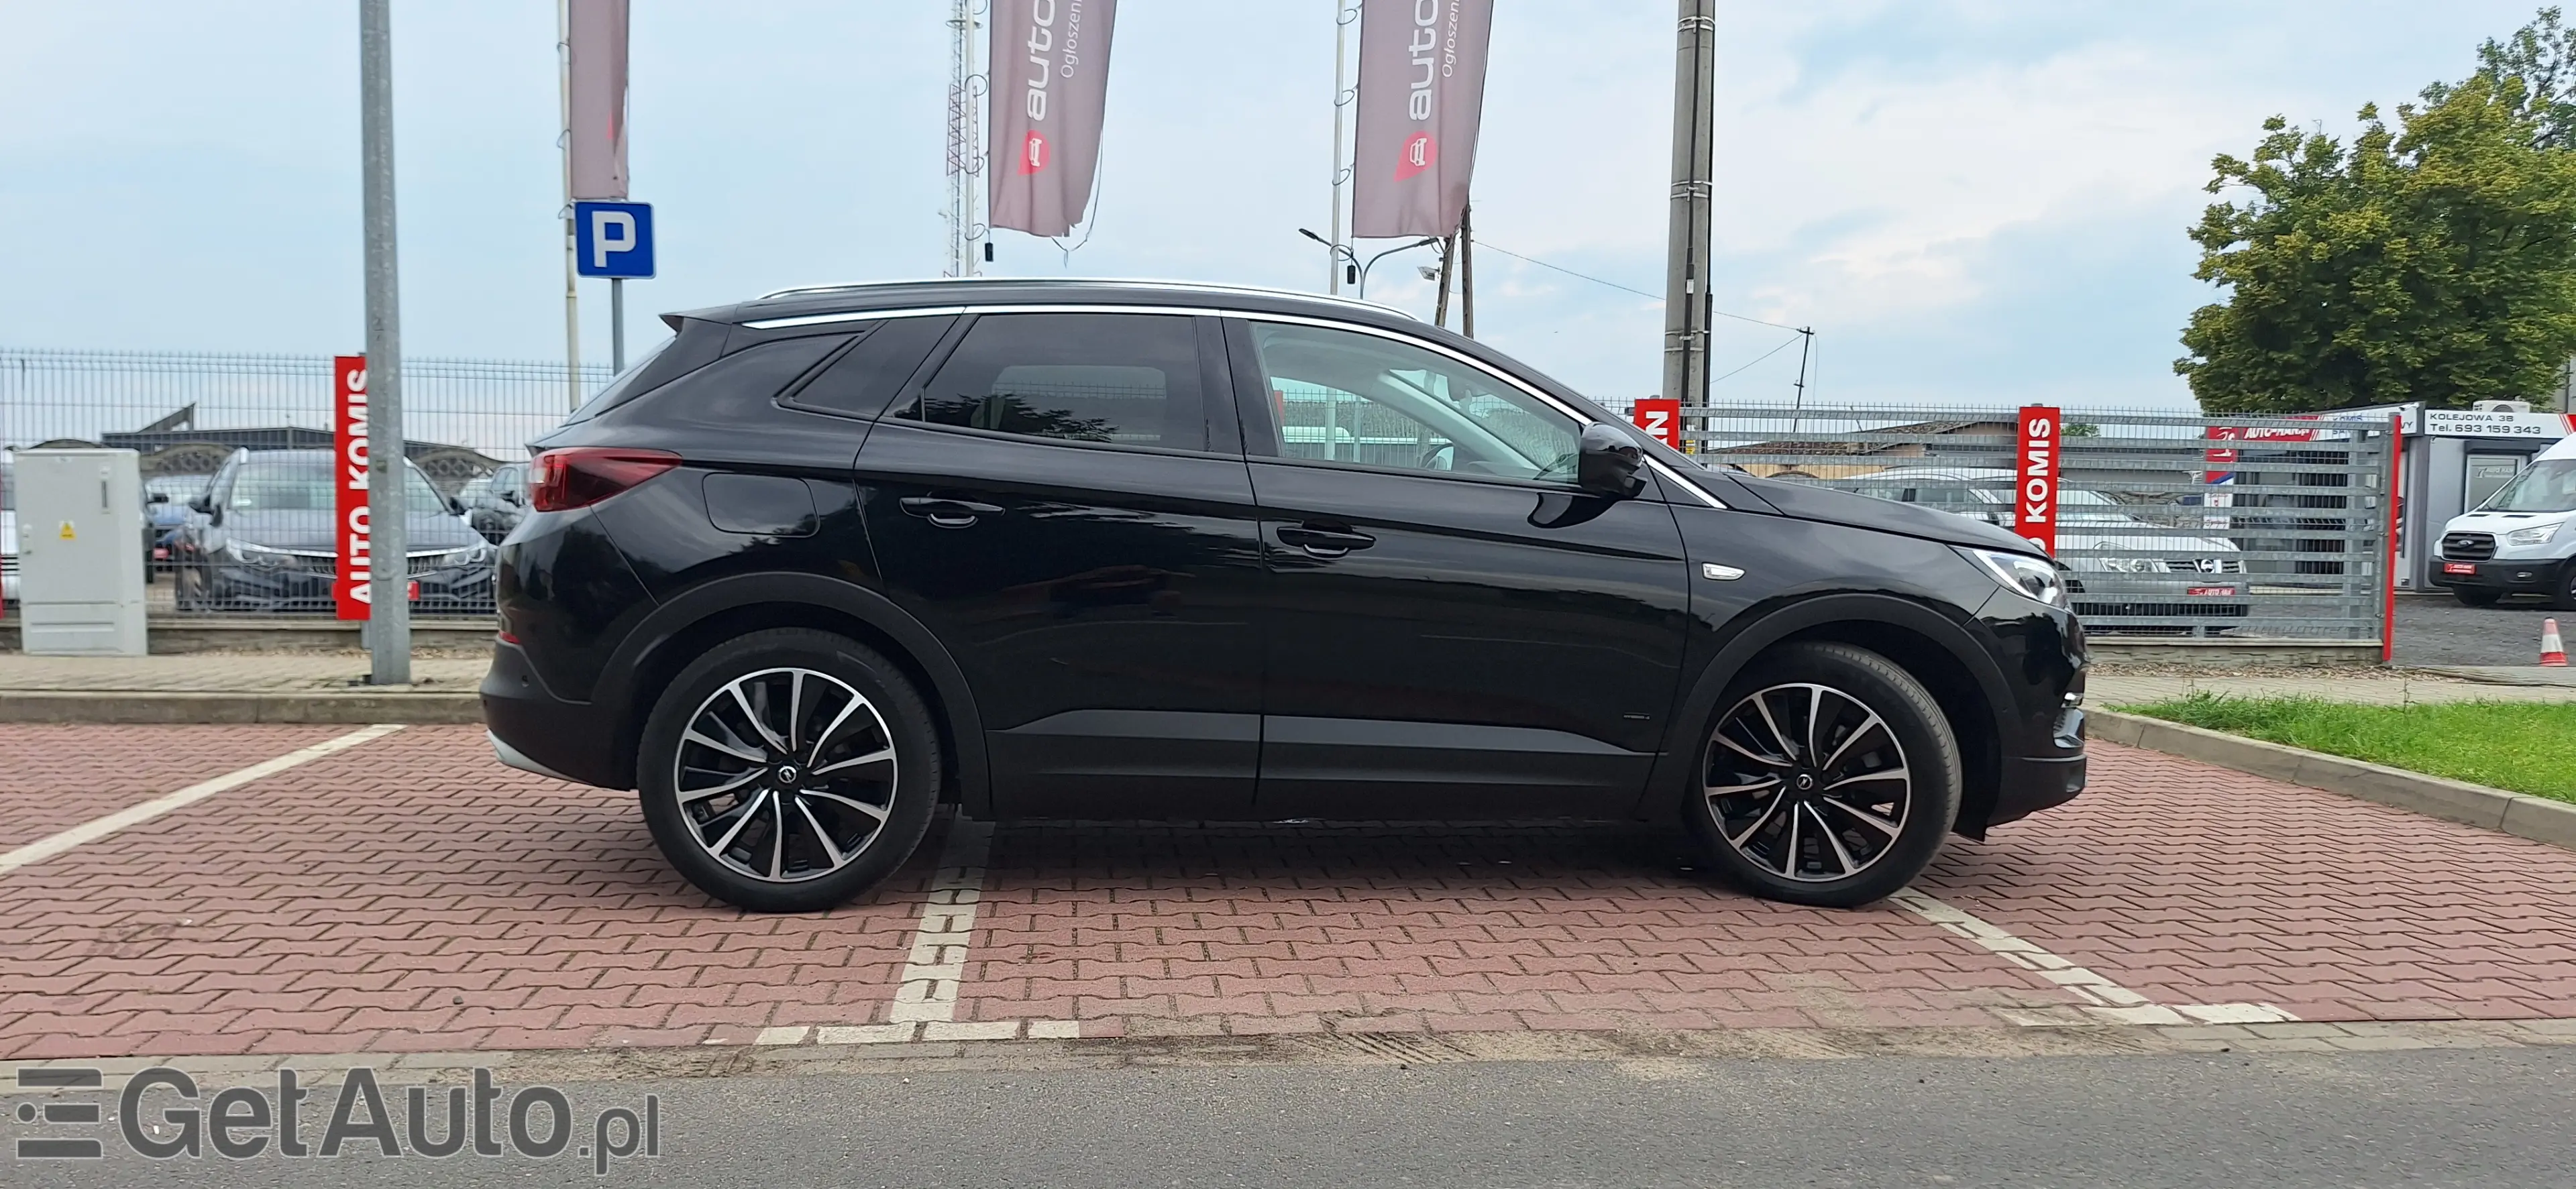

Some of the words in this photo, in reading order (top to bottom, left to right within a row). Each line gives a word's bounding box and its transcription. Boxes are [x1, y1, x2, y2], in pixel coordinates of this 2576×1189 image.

[592, 210, 637, 268] P
[347, 369, 370, 490] KOMIS
[2430, 413, 2493, 422] KOLEJOWA
[2430, 424, 2452, 432] Tel.
[2455, 424, 2482, 433] 693
[2486, 425, 2510, 433] 159
[2025, 418, 2051, 523] KOMIS
[350, 506, 372, 604] AUTO
